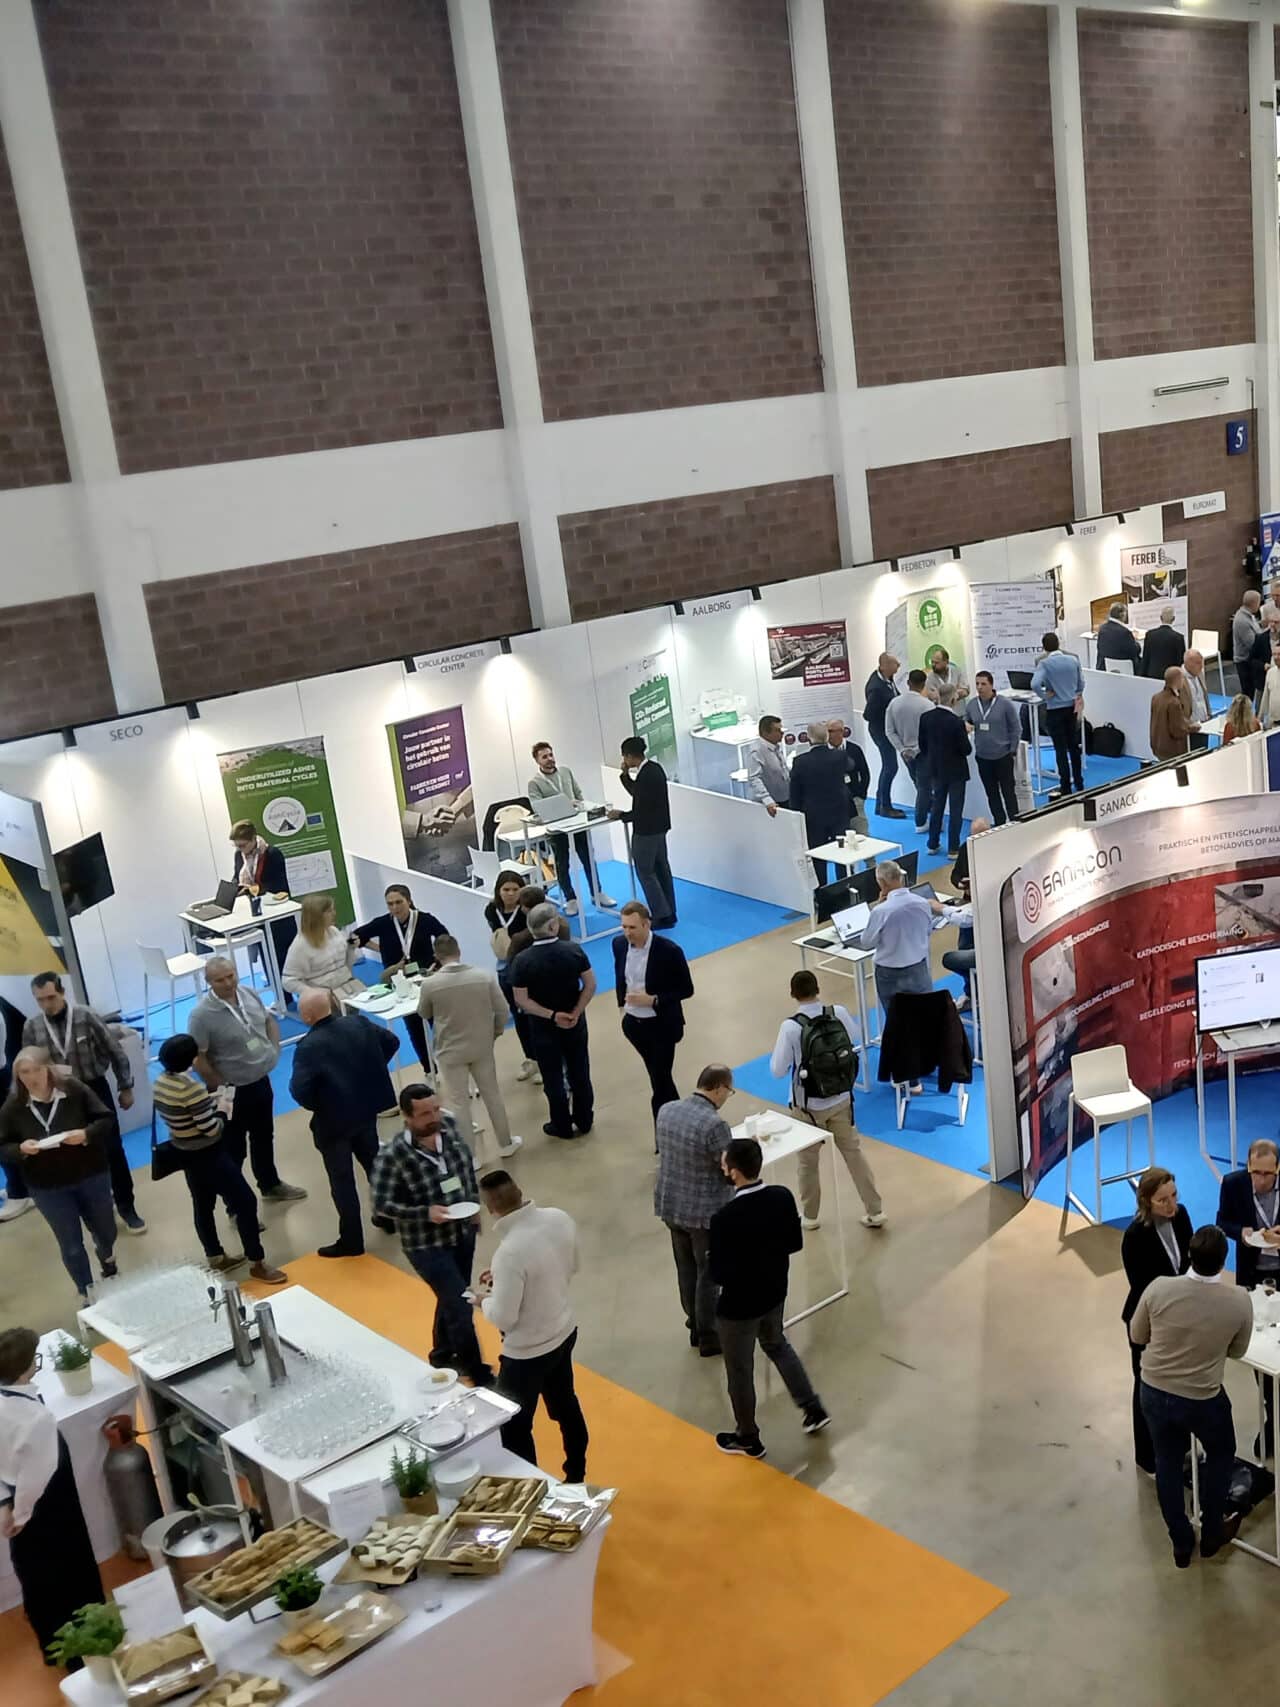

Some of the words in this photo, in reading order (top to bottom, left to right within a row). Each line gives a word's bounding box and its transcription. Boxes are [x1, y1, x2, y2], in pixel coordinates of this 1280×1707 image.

[1234, 425, 1244, 449] 5
[1079, 525, 1097, 536] FEREB
[901, 559, 937, 572] FEDBETON
[1131, 551, 1157, 566] FEREB
[692, 601, 732, 616] AALBORG
[417, 655, 450, 669] CIRCULAR
[451, 649, 485, 662] CONCRETE
[997, 646, 1044, 655] FEDBETO
[440, 662, 465, 674] CENTER
[109, 724, 144, 742] SECO
[255, 777, 291, 788] MATERIAL
[1100, 792, 1140, 817] SANACO
[1158, 837, 1199, 852] PRAKTISCH
[1200, 835, 1211, 843] EN
[1200, 839, 1254, 855] BETONADVIES
[1254, 837, 1267, 846] OP
[1136, 937, 1186, 959] KATHODISCHE
[1187, 926, 1244, 945] BESCHERMING
[1139, 1000, 1186, 1021] BEGELEIDING
